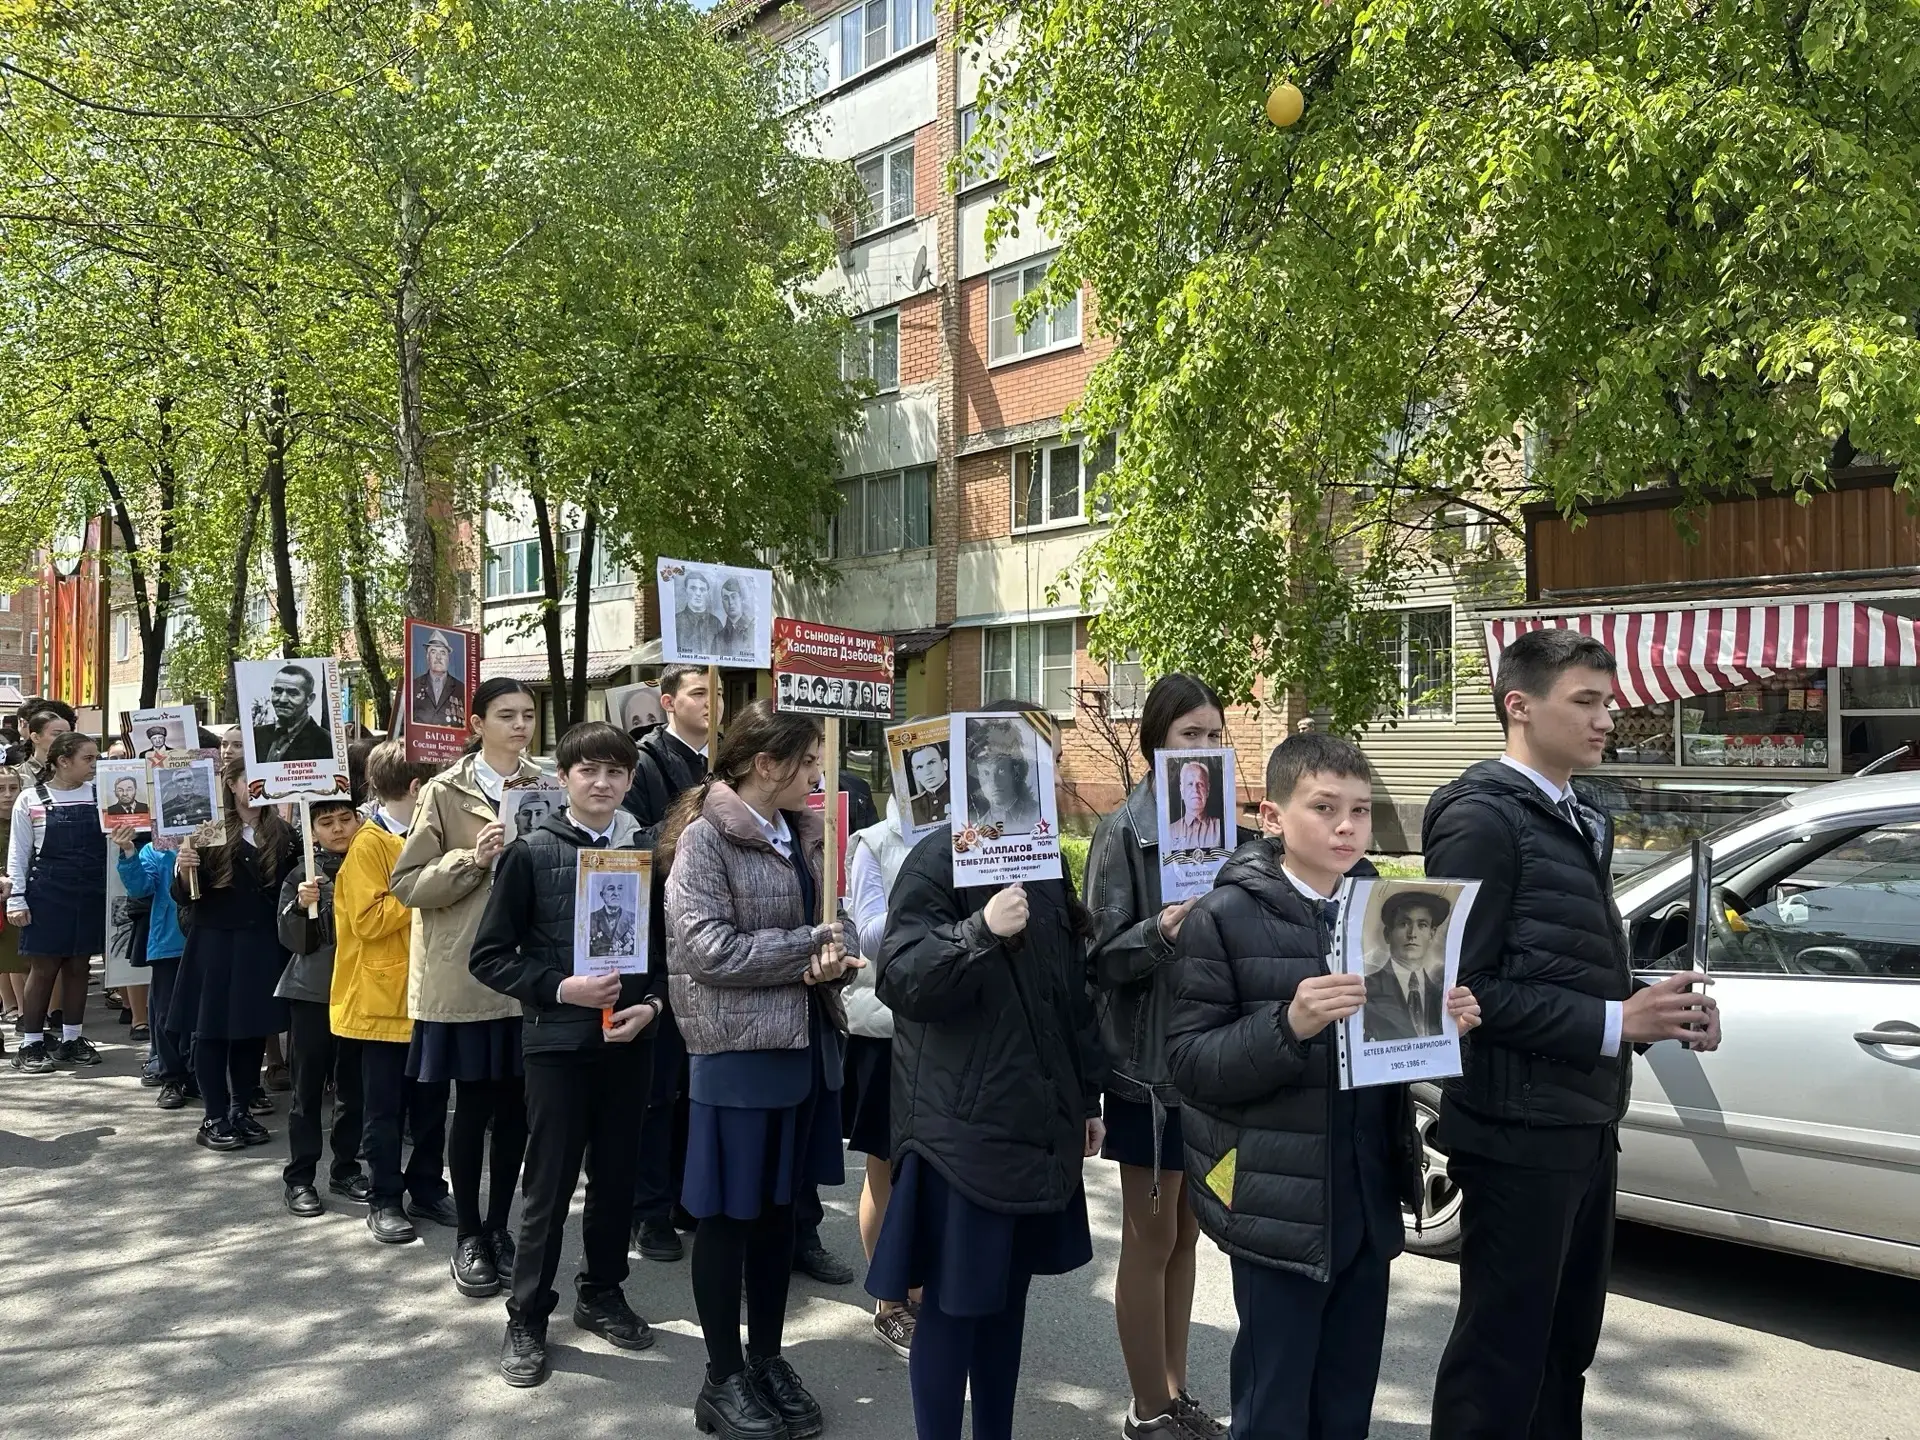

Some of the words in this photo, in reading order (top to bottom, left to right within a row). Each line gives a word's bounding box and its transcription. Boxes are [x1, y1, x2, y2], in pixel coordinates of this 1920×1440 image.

[795, 625, 802, 639] 6
[803, 629, 846, 646] сыновей
[847, 637, 854, 646] и
[855, 638, 877, 652] внук
[787, 639, 838, 658] Касполата
[840, 646, 884, 664] Дзебоева
[328, 660, 338, 688] ПОЛК
[329, 692, 347, 772] БЕССМЕРТНЫЙ
[425, 731, 456, 742] БАГАЕВ
[412, 740, 437, 749] Сослан
[283, 761, 317, 769] ЛЕВЧЕНКО
[287, 768, 314, 776] Георгий
[275, 774, 327, 782] Константинович
[982, 844, 1033, 855] КАЛЛАГОВ
[955, 856, 1000, 867] ТЕМБУЛАТ
[1002, 852, 1060, 864] ТИМОФЕЕВИЧ
[1363, 1049, 1385, 1057] БЕТЕЕВ
[1385, 1042, 1412, 1054] АЛЕКСЕЙ
[1412, 1039, 1452, 1051] ГАВРИЛОВИЧ
[1391, 1059, 1420, 1070] 1905-1986
